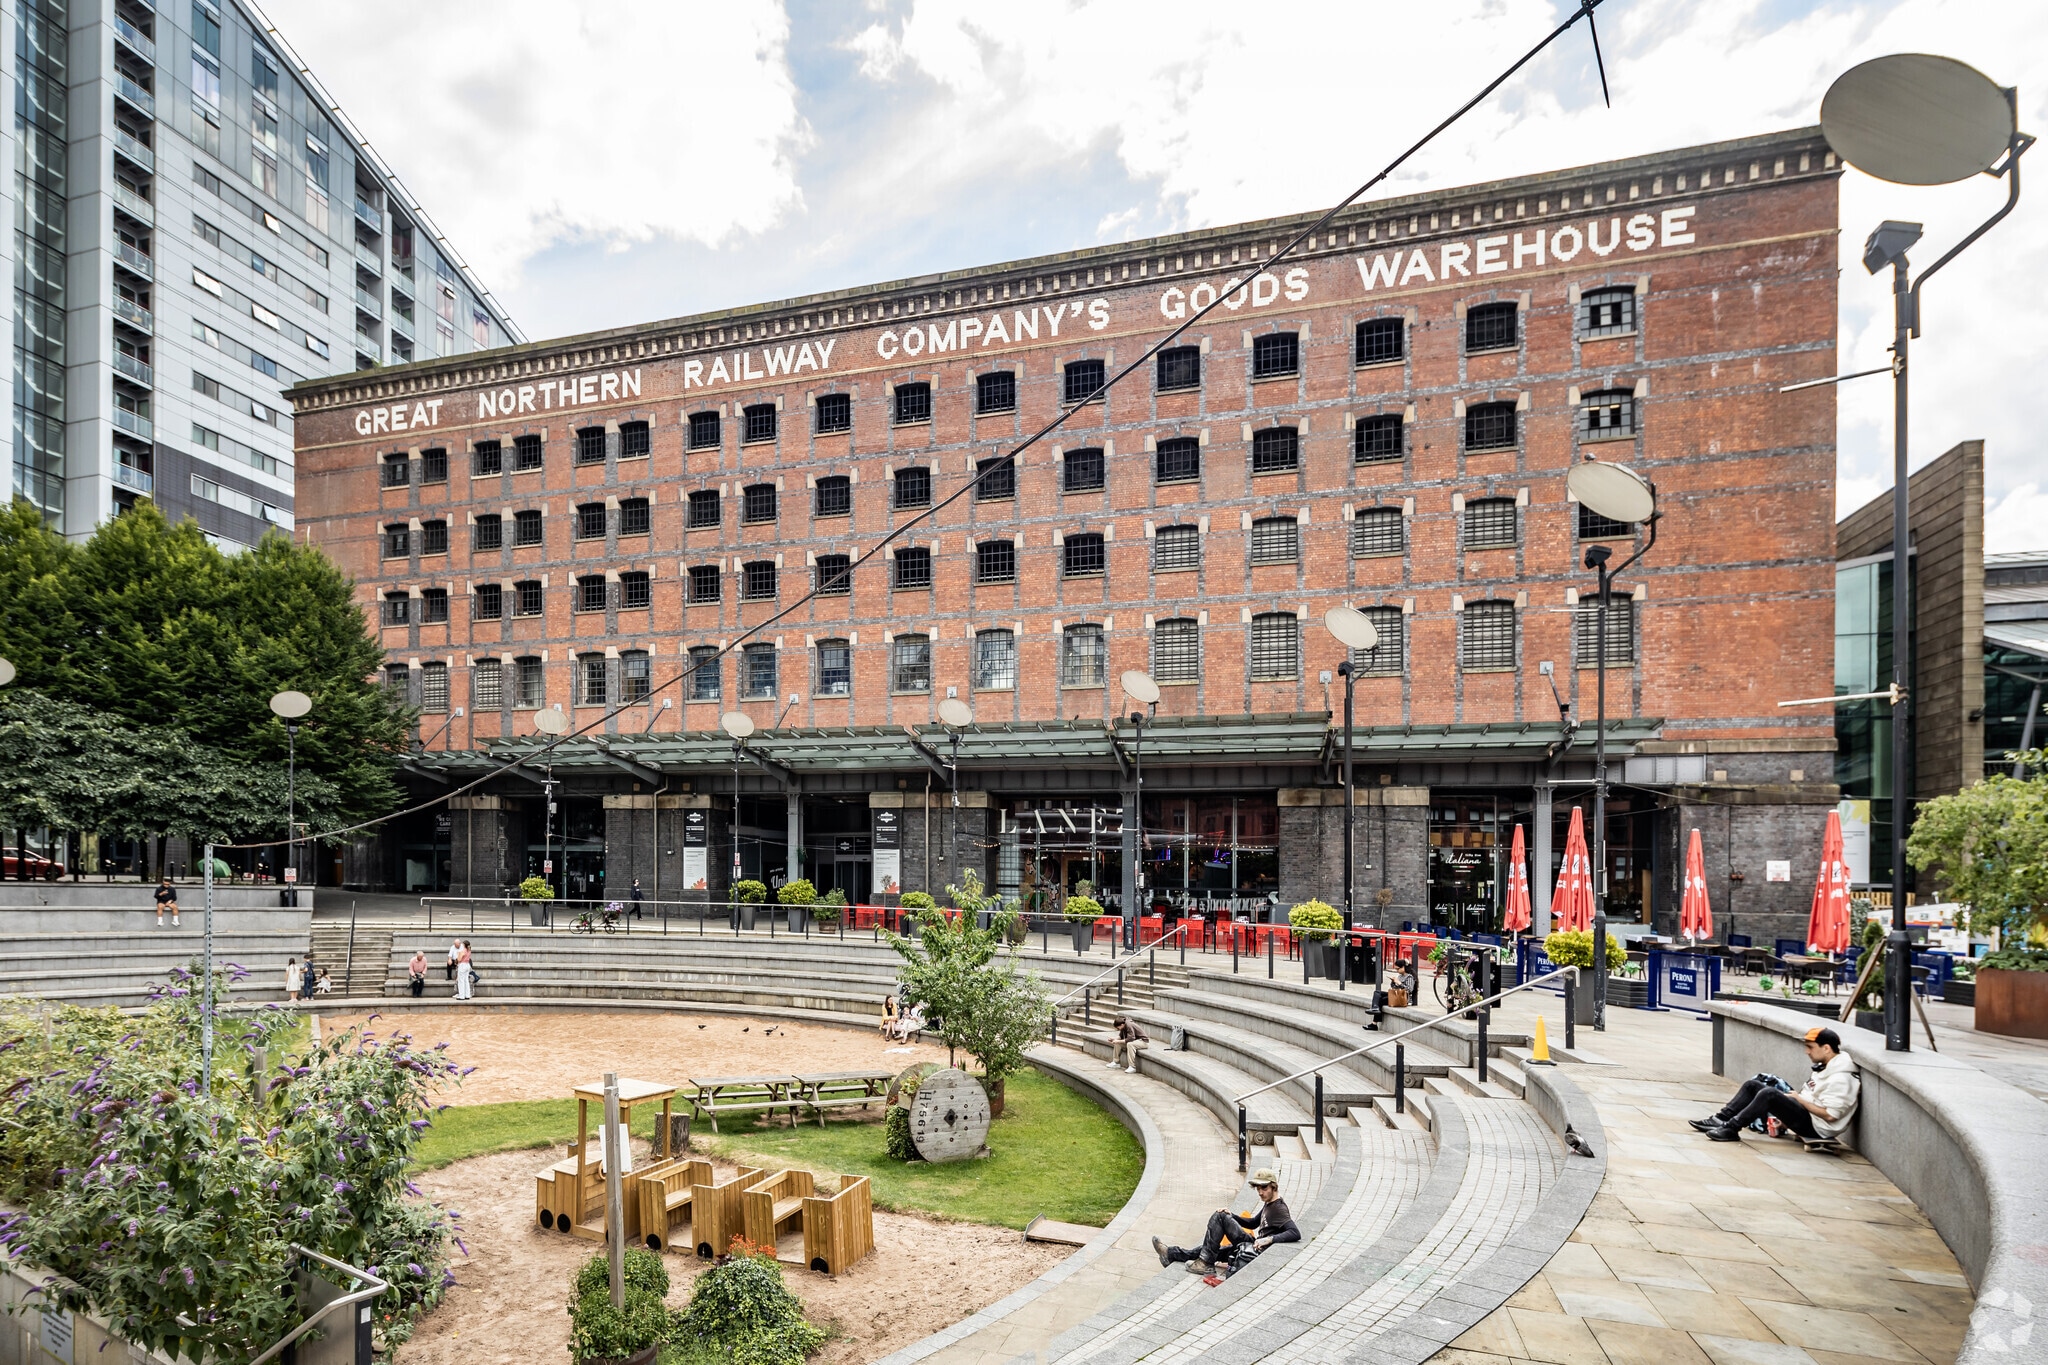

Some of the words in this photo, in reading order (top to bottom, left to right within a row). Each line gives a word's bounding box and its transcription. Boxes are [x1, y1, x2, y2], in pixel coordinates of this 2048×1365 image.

[355, 399, 443, 436] GREAT
[479, 368, 641, 419] NORTHERN
[684, 338, 837, 389] RAILWAY
[877, 298, 1110, 360] COMPANY'S
[1160, 267, 1310, 320] GOODS
[1356, 206, 1695, 291] WAREHOUSE
[1671, 971, 1694, 983] PERONI
